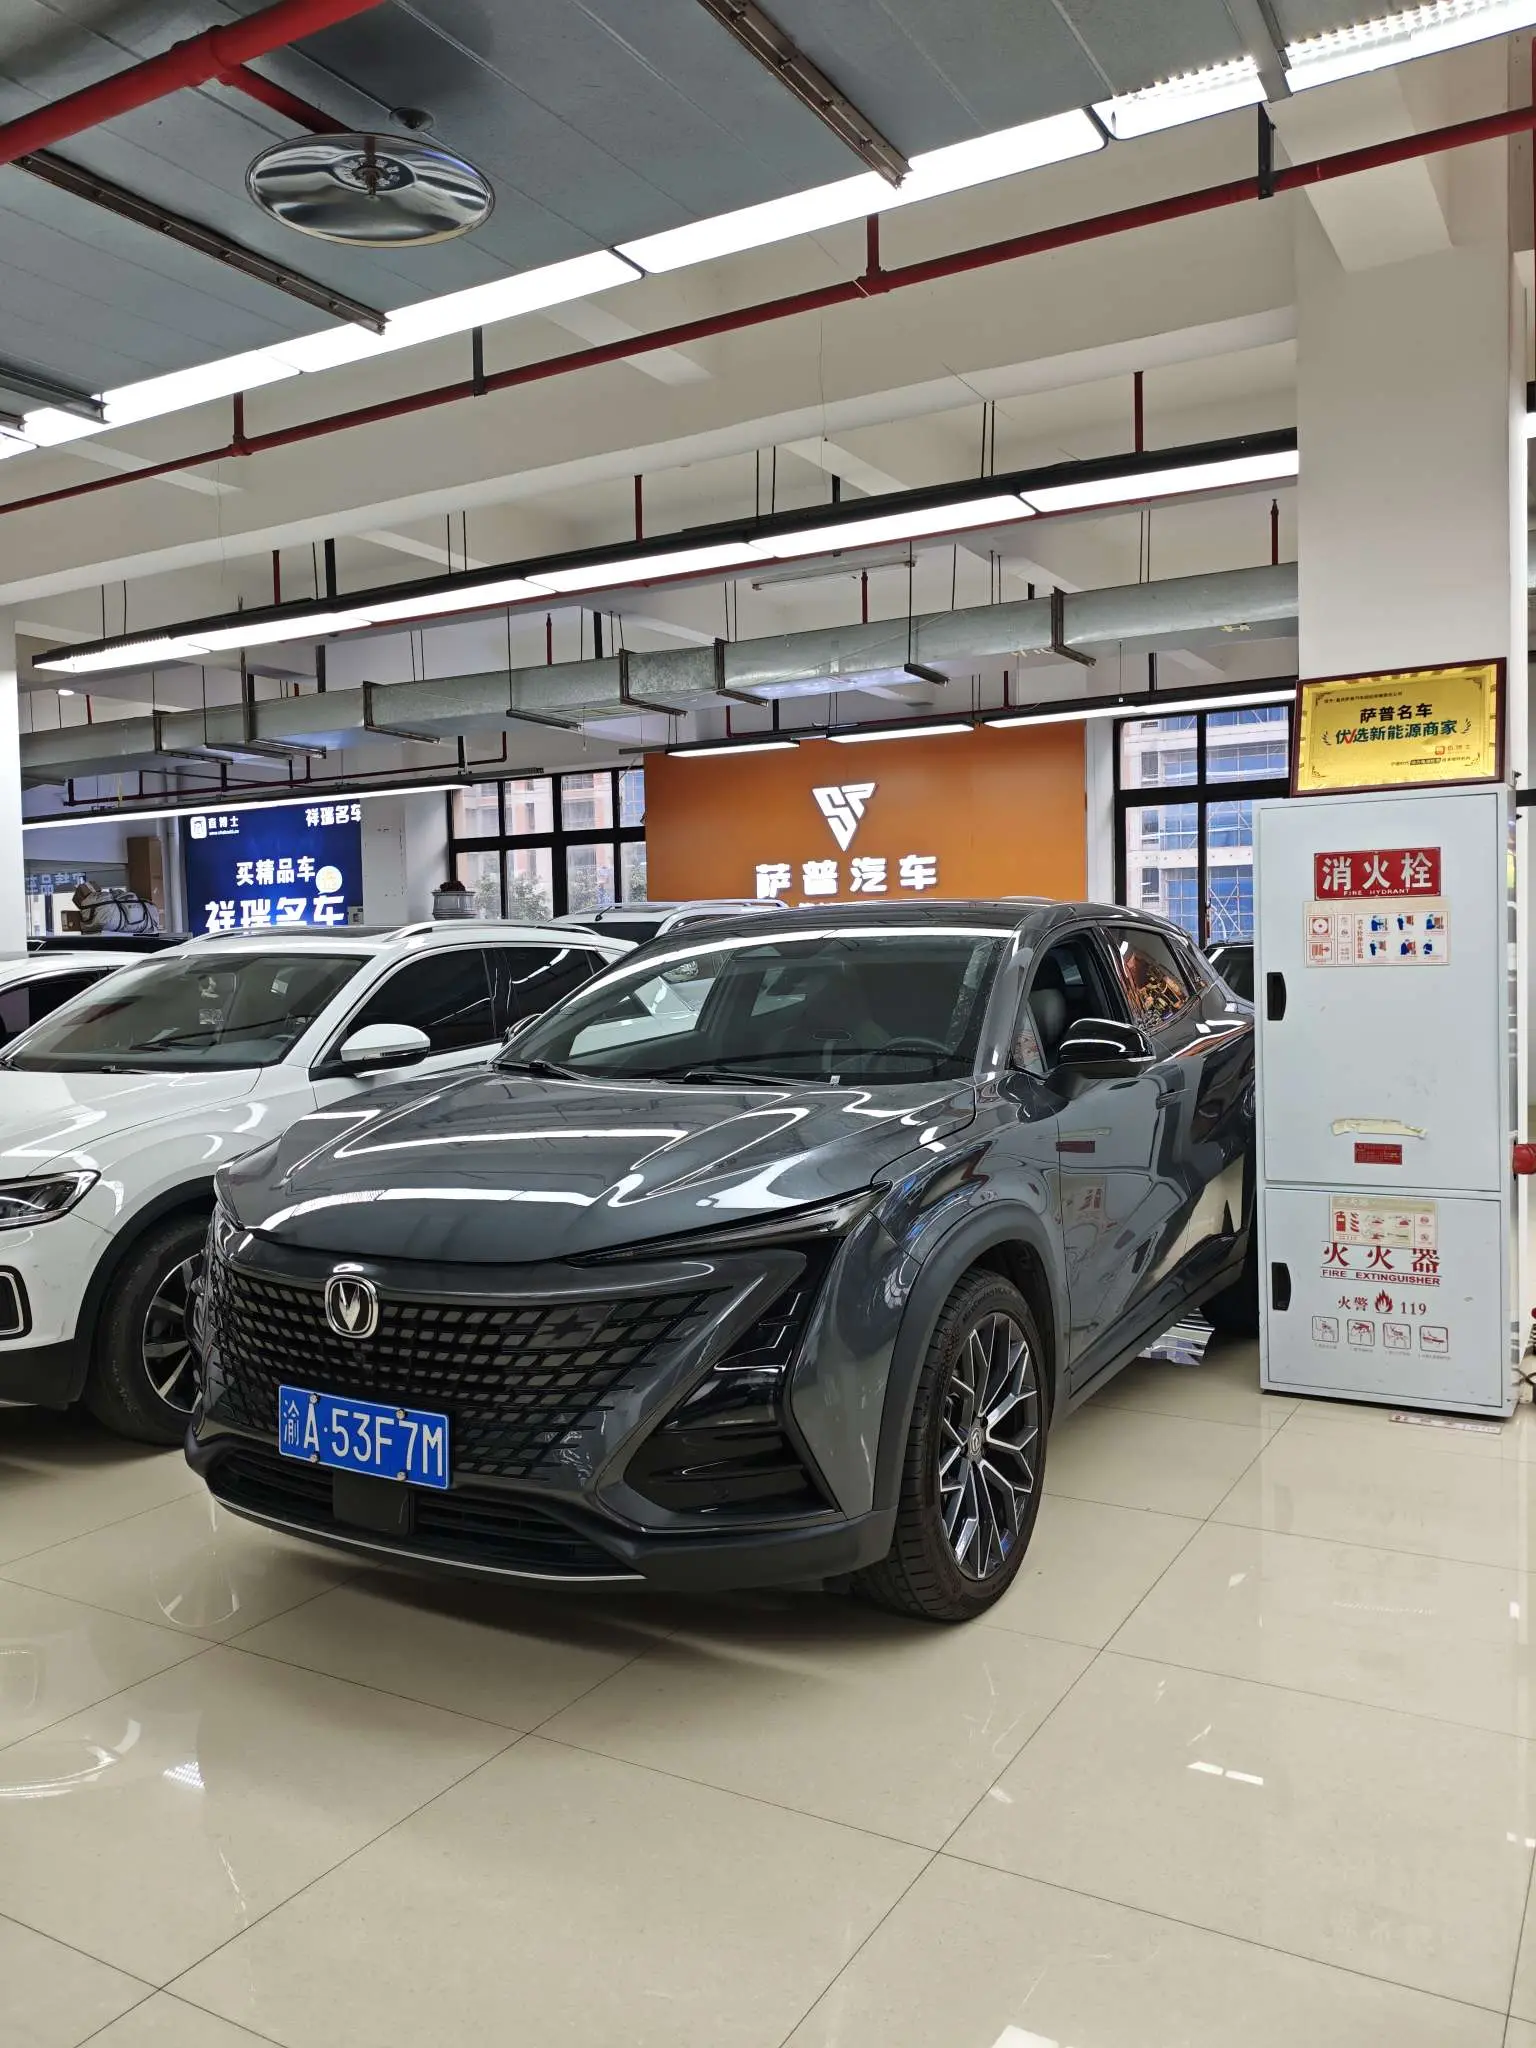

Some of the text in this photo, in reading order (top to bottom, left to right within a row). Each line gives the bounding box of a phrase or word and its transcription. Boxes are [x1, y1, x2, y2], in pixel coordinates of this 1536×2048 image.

[1360, 703, 1433, 724] 萨普名车
[1335, 719, 1458, 745] 优选新能源商家
[236, 856, 316, 886] 买精品车
[756, 855, 937, 899] 萨普汽车
[1322, 852, 1432, 891] 消火栓
[1322, 1269, 1441, 1285] FIRE EXTINGUISHER
[1338, 1295, 1427, 1315] 火警 119
